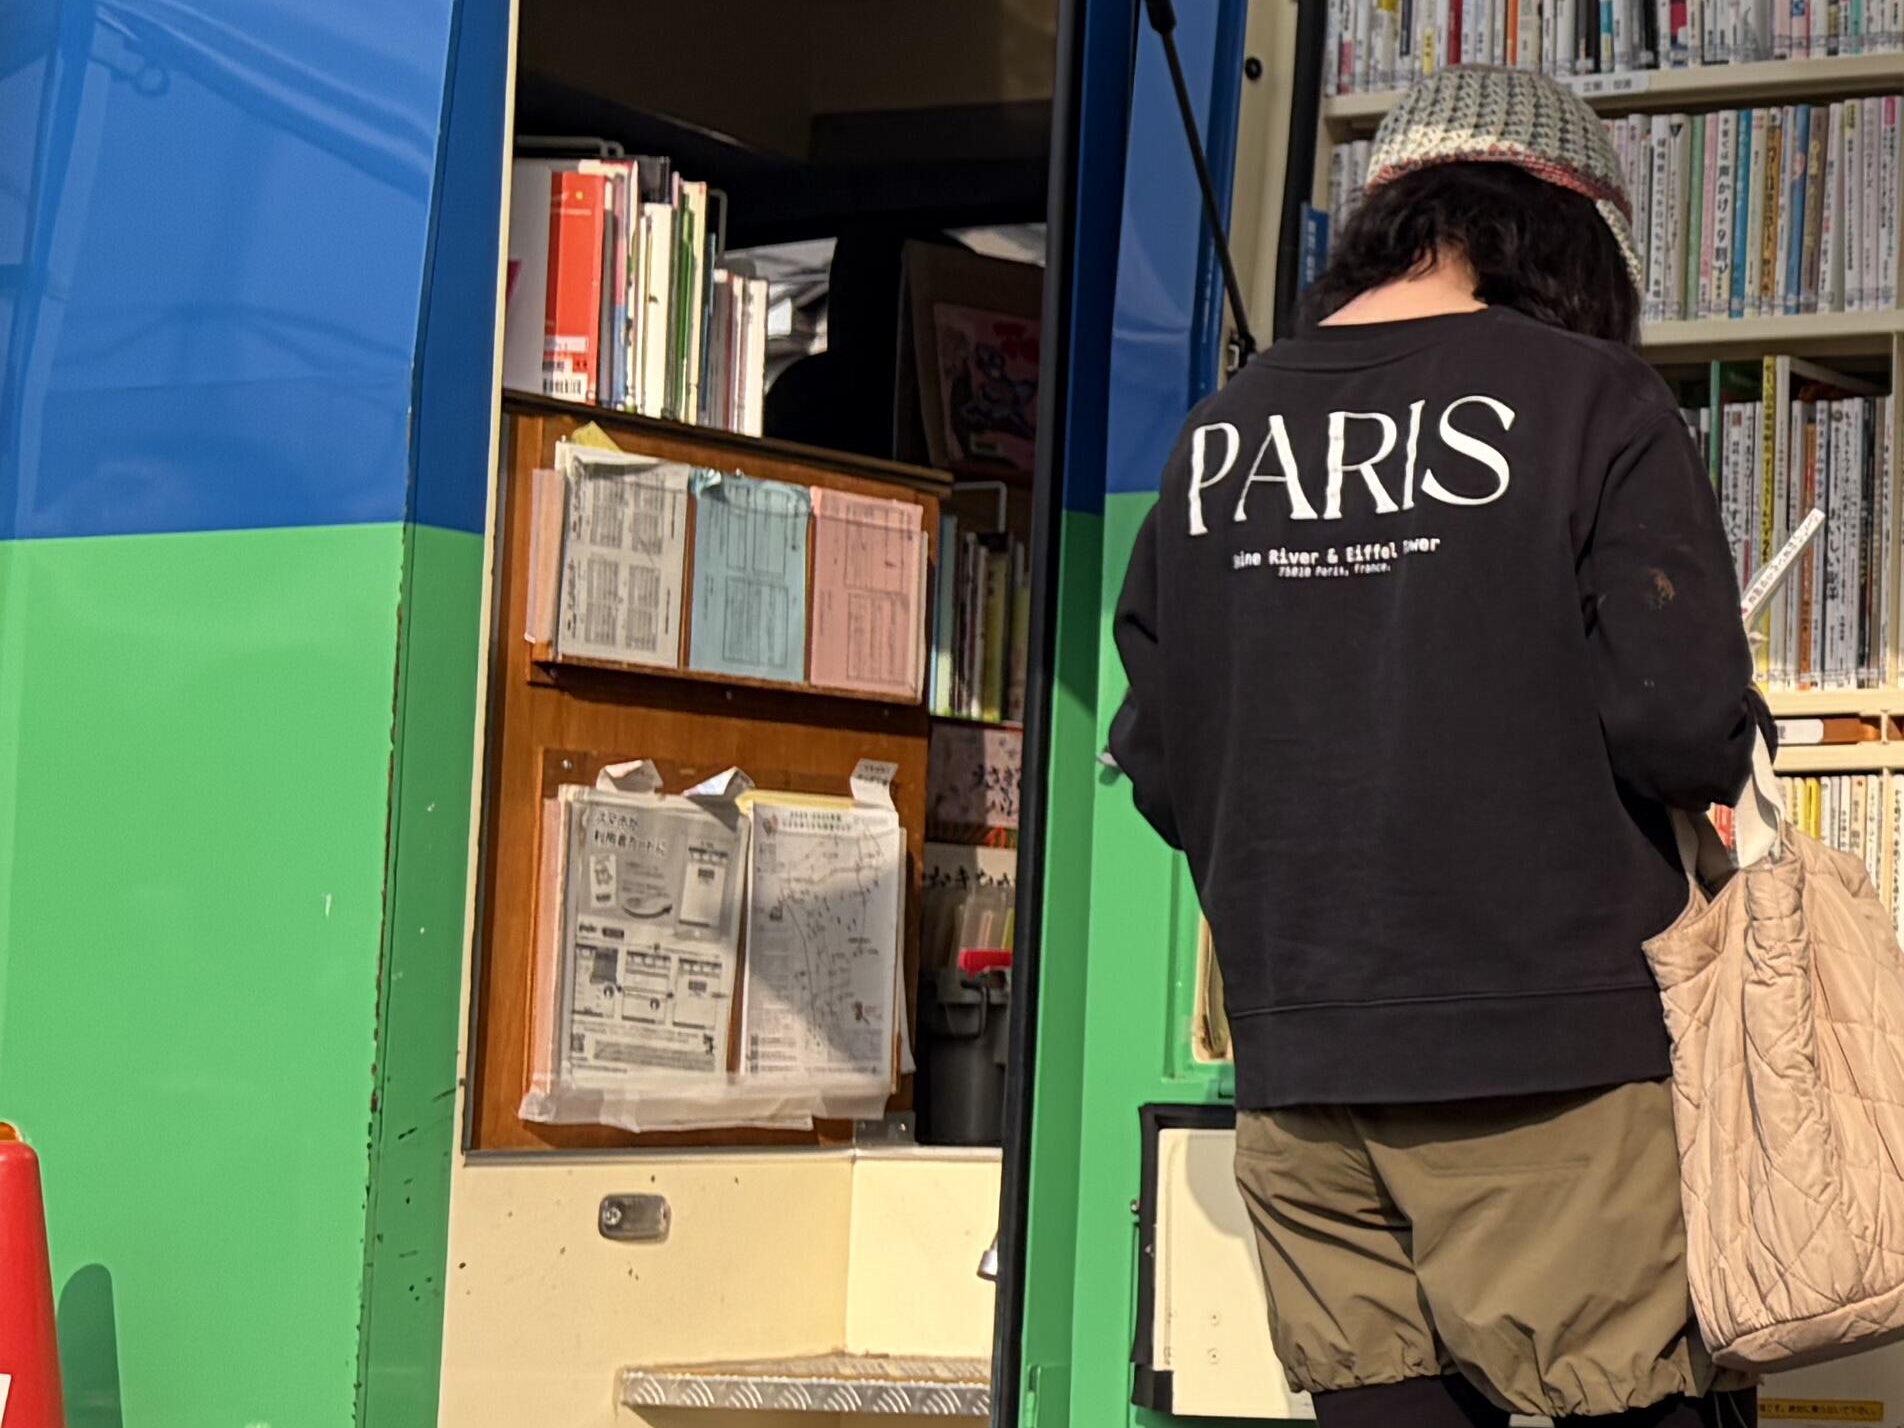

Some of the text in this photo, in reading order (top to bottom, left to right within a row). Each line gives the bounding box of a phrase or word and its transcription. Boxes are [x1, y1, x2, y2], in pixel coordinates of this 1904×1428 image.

[1188, 395, 1517, 537] PARIS
[1268, 548, 1319, 565] River
[1327, 548, 1339, 564] &
